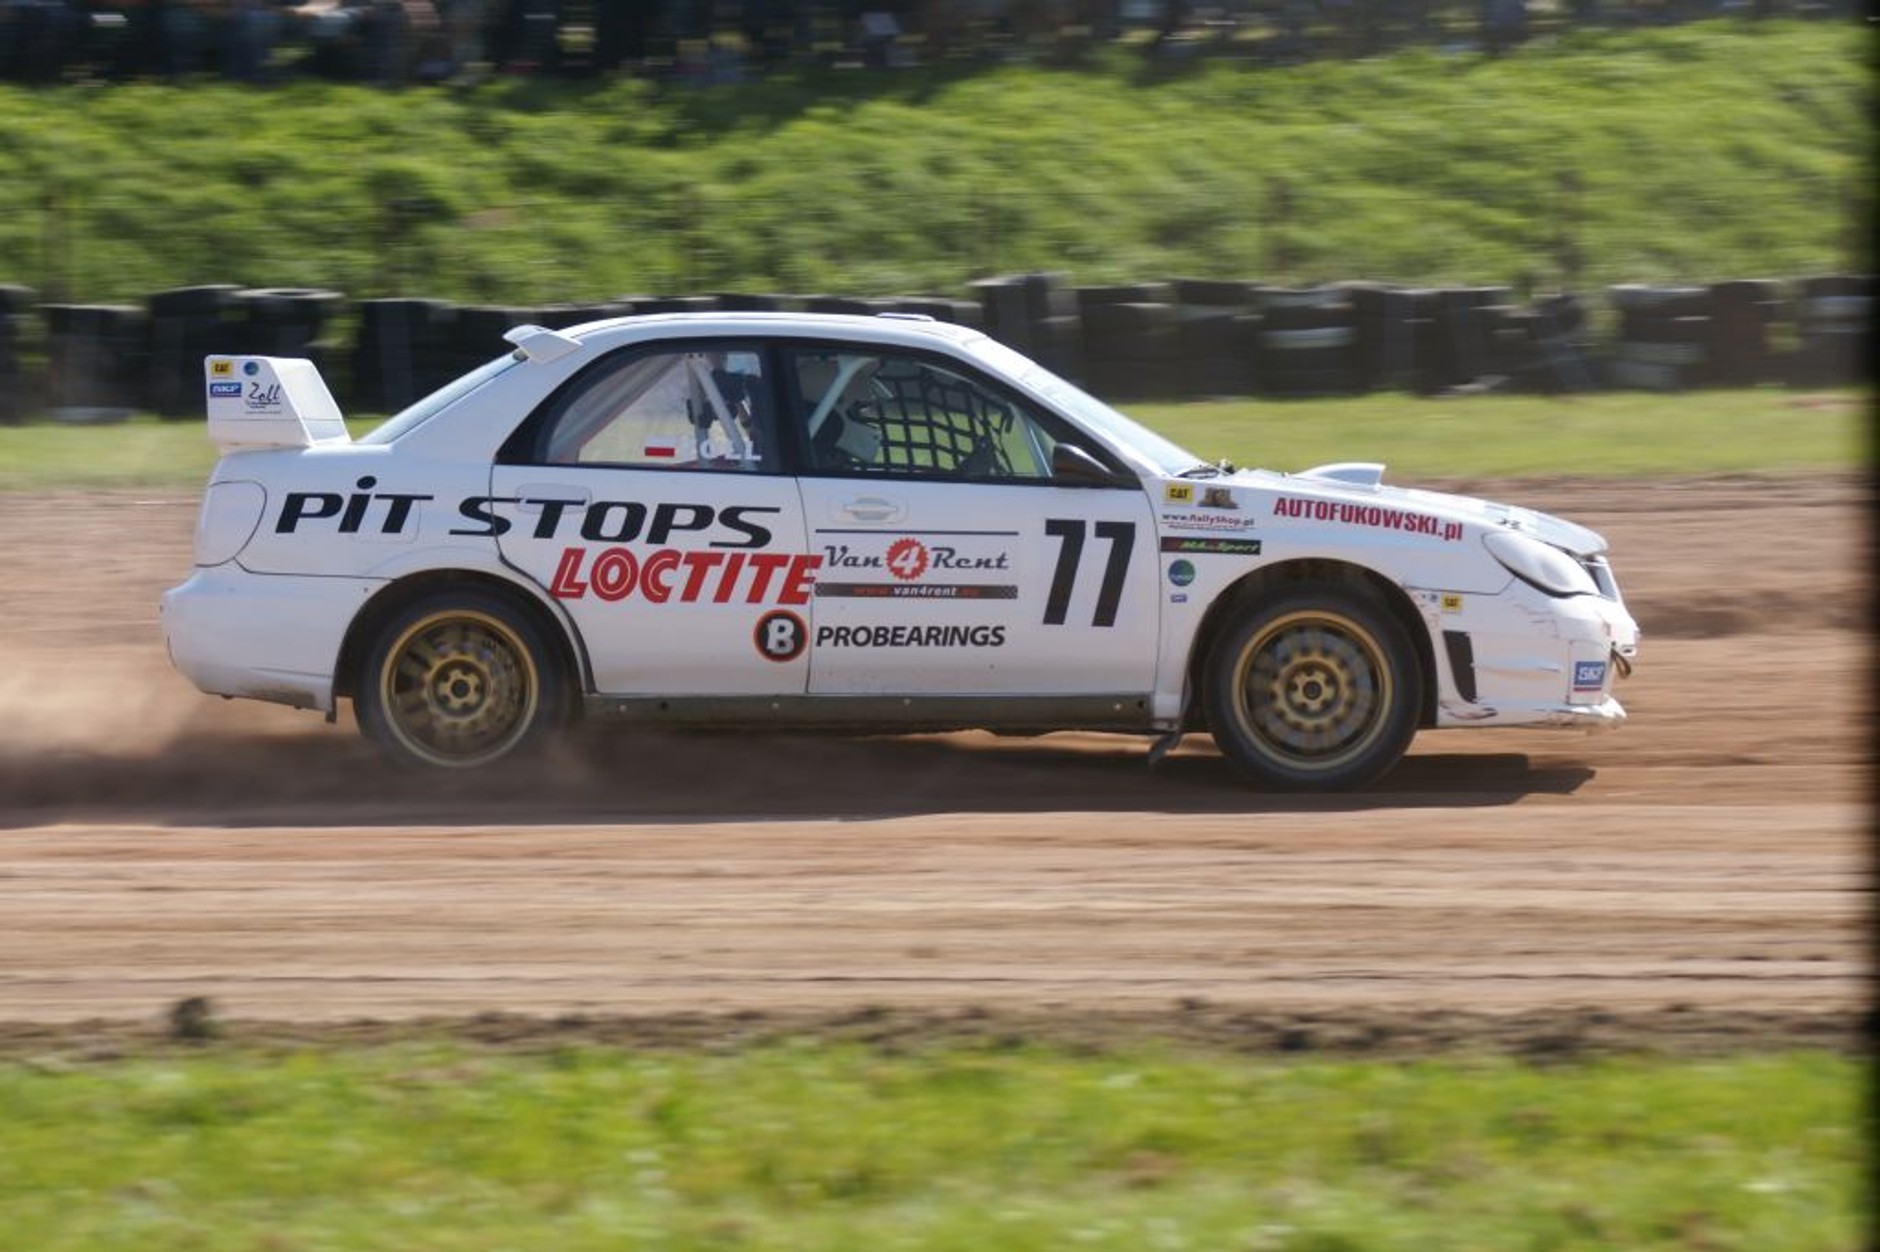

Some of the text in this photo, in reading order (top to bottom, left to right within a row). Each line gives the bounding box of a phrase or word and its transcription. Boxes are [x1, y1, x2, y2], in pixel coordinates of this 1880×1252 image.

[685, 439, 762, 460] OLL
[449, 495, 781, 549] STOPS
[1273, 497, 1463, 541] AUTOFUKOWSKI.pl
[550, 547, 824, 605] LOCTITE
[824, 545, 883, 568] Van
[930, 546, 1010, 570] Rent
[1042, 518, 1136, 627] 77
[815, 625, 1006, 648] PROBEARINGS
